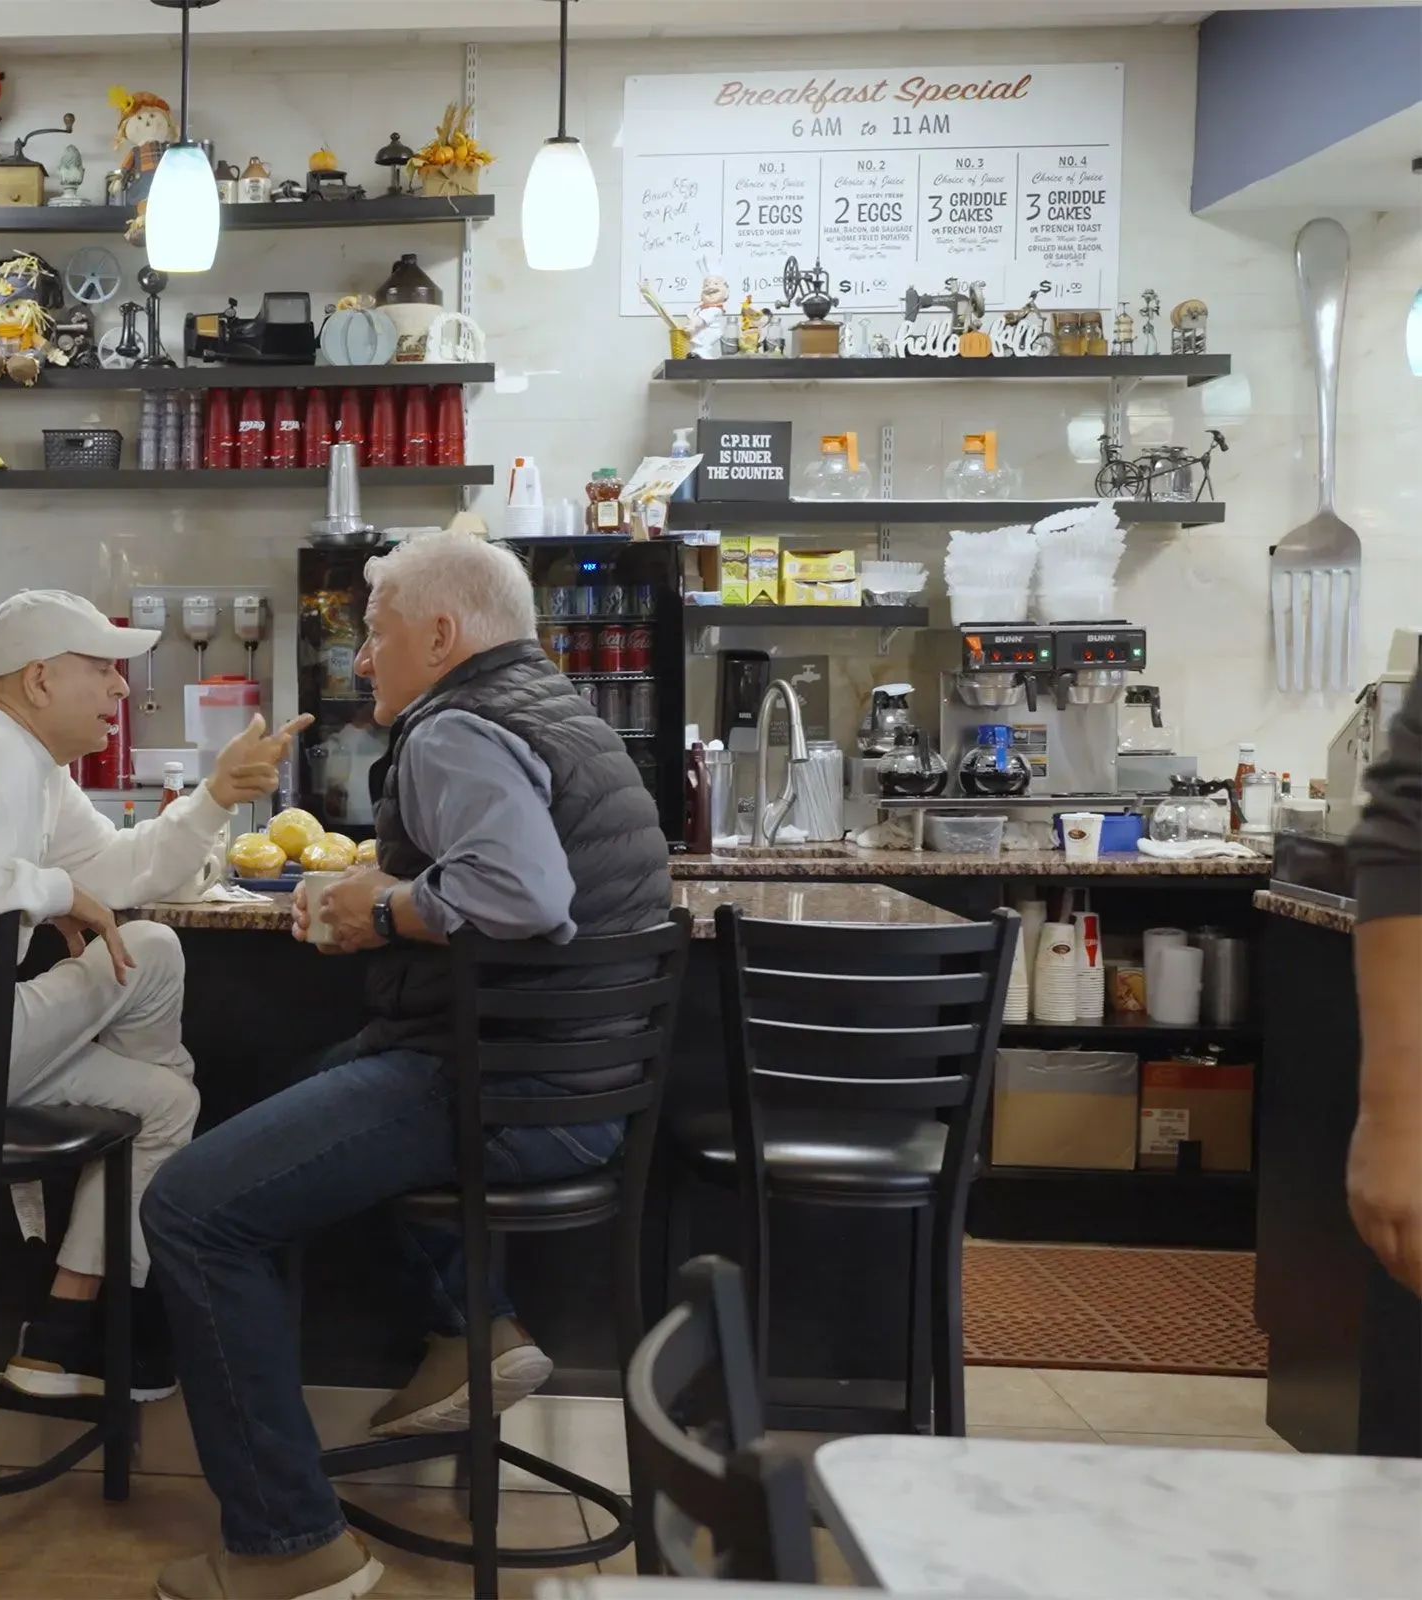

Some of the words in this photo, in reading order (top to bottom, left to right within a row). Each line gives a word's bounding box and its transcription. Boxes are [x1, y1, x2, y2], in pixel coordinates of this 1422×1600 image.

[714, 78, 888, 114] Breakfast
[894, 74, 1032, 109] Special
[791, 118, 804, 137] 6
[810, 117, 842, 137] AM
[861, 120, 877, 136] to
[891, 116, 912, 135] 11
[918, 114, 950, 134] AM
[759, 163, 777, 173] NO.
[858, 160, 876, 171] NO.
[879, 160, 885, 171] 2
[956, 158, 974, 169] NO.
[977, 157, 984, 168] 3
[1059, 156, 1077, 167] NO.
[1080, 155, 1087, 166] 4
[834, 176, 863, 188] Choice
[934, 173, 964, 187] Choice
[980, 173, 1005, 187] Juice
[1031, 171, 1062, 185] Choice
[1078, 171, 1104, 185] Juice
[736, 199, 751, 226] 2
[758, 204, 803, 224] EGGS
[835, 197, 850, 224] 2
[858, 202, 902, 222] EGGS
[927, 195, 943, 223] 3
[949, 192, 1007, 207] GRIDDLE
[1026, 193, 1041, 221] 3
[1048, 190, 1106, 205] GRIDDLE
[949, 207, 993, 223] CAKES
[1048, 206, 1092, 221] CAKES
[738, 229, 765, 237] SERVED
[766, 229, 784, 237] YOUR
[942, 226, 976, 235] FRENCH
[977, 225, 1003, 234] TOAST
[1040, 224, 1074, 233] FRENCH
[1076, 223, 1102, 232] TOAST
[1028, 244, 1056, 252] GRILLED
[1055, 252, 1086, 260] SAUSAGE
[891, 320, 960, 359] hello
[752, 434, 772, 448] KIT
[720, 450, 731, 464] IS
[733, 450, 772, 464] UNDER
[707, 466, 730, 480] THE
[731, 466, 784, 480] COUNTER
[1087, 634, 1116, 642] BUNN
